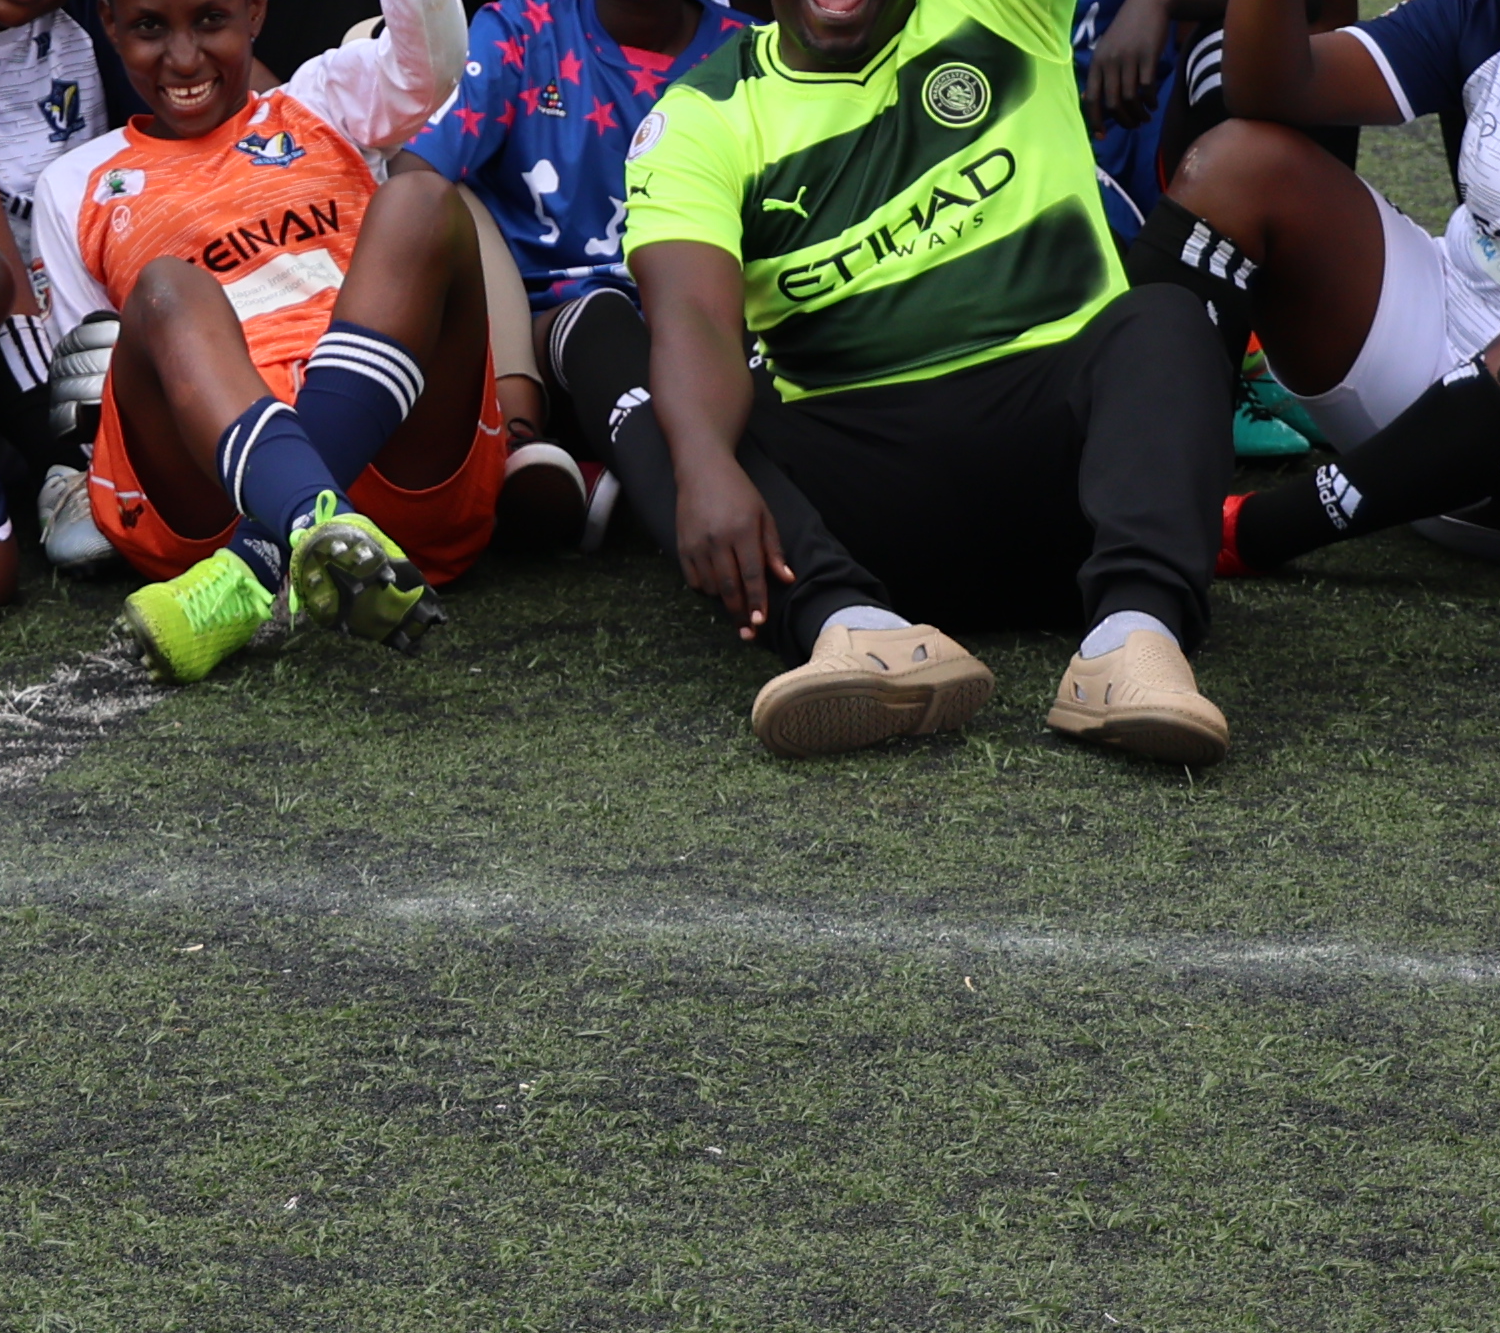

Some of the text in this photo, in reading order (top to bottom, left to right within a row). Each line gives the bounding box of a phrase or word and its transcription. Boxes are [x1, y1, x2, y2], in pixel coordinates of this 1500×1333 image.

[776, 146, 1017, 302] ETIHAD
[894, 211, 985, 258] WAYS
[1315, 464, 1348, 532] adidas
